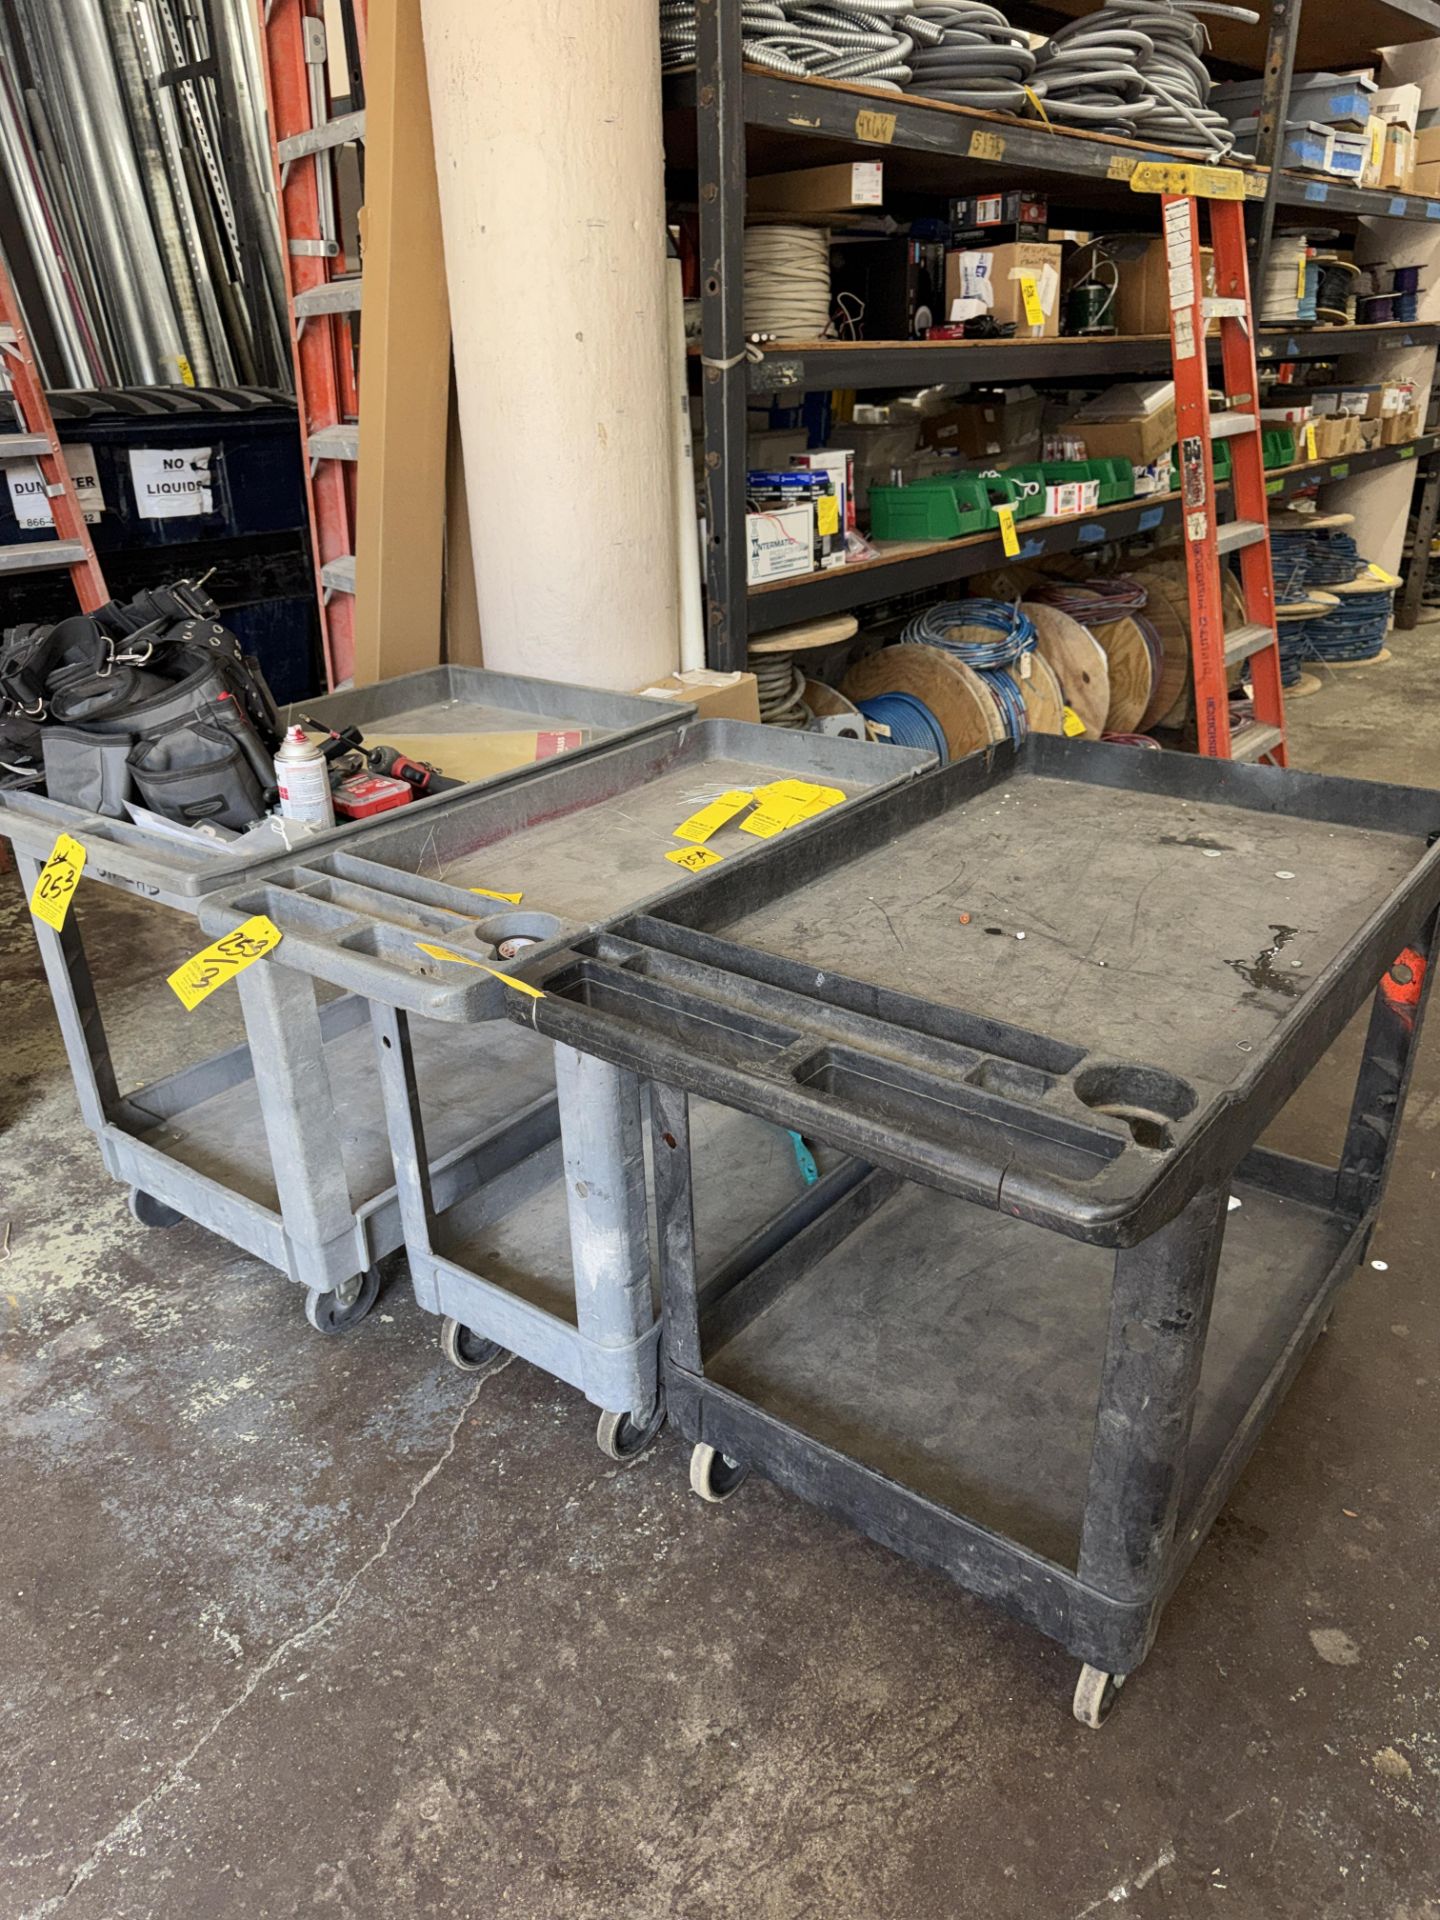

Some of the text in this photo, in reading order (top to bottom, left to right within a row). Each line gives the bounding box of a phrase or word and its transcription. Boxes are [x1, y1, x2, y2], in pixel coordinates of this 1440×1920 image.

[163, 458, 184, 470] NO
[40, 869, 75, 899] 253
[217, 932, 269, 958] 253
